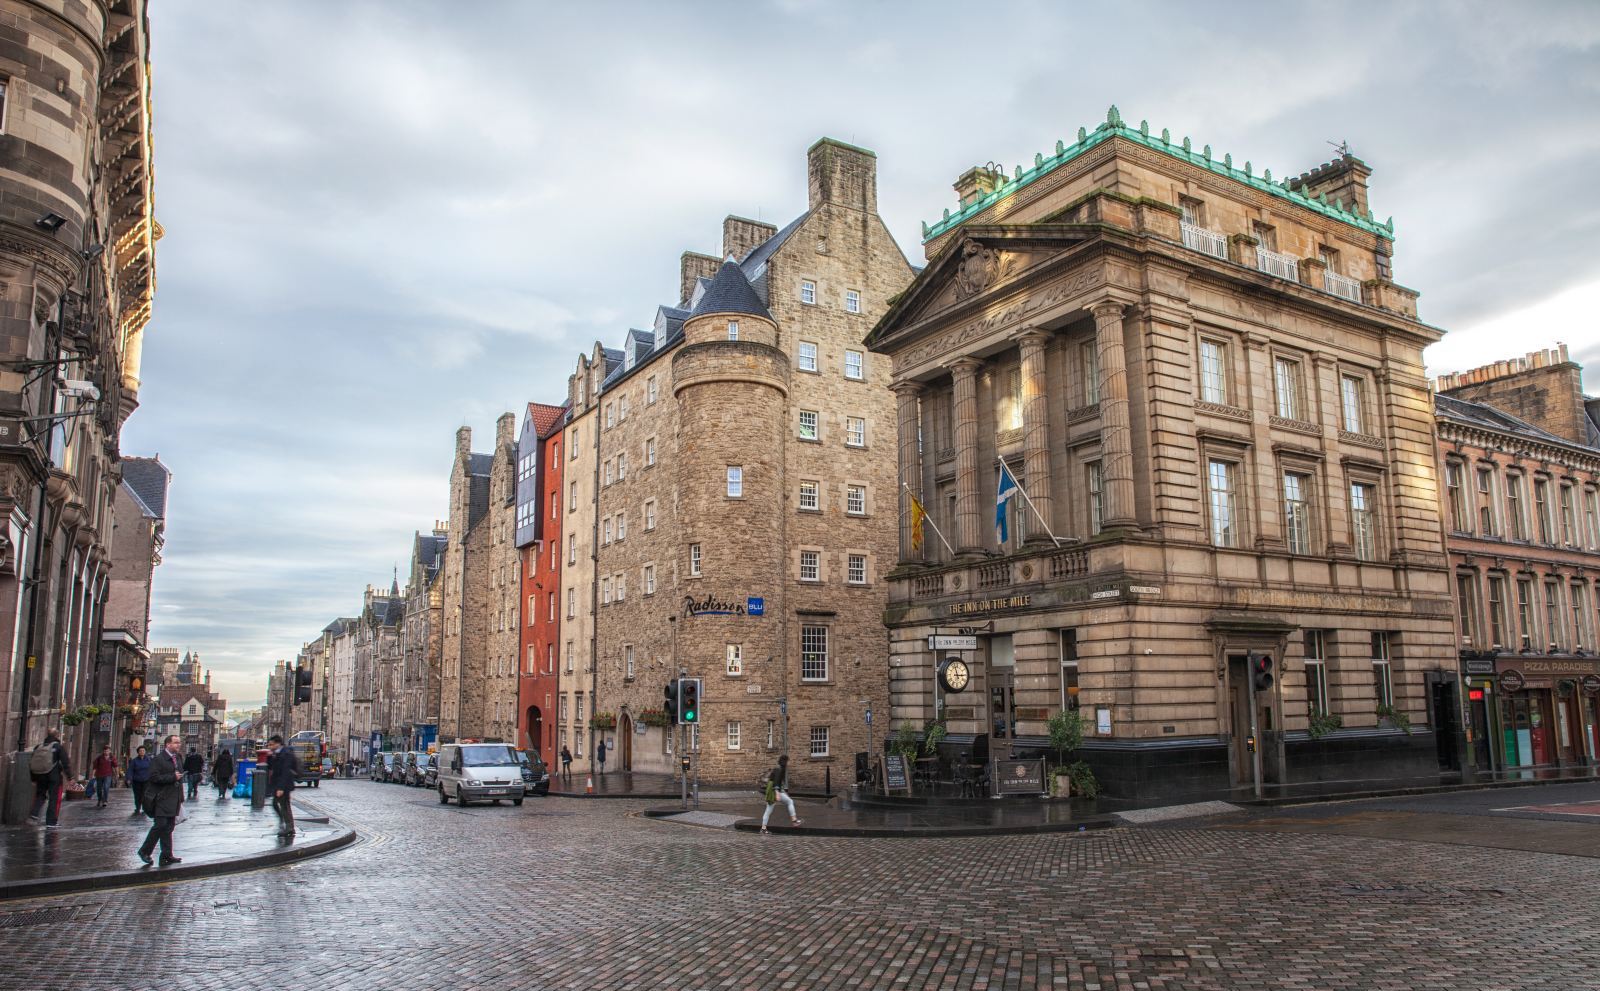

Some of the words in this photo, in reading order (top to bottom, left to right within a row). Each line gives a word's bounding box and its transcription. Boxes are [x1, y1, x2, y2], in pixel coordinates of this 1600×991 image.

[1001, 301, 1029, 324] ART
[684, 594, 745, 618] Radisson
[949, 604, 962, 615] THE
[964, 602, 978, 612] INN
[980, 600, 991, 611] ON
[992, 597, 1008, 609] THE
[1010, 594, 1030, 607] MILE
[1524, 662, 1550, 671] PIZZA
[1552, 662, 1593, 671] PARADISE
